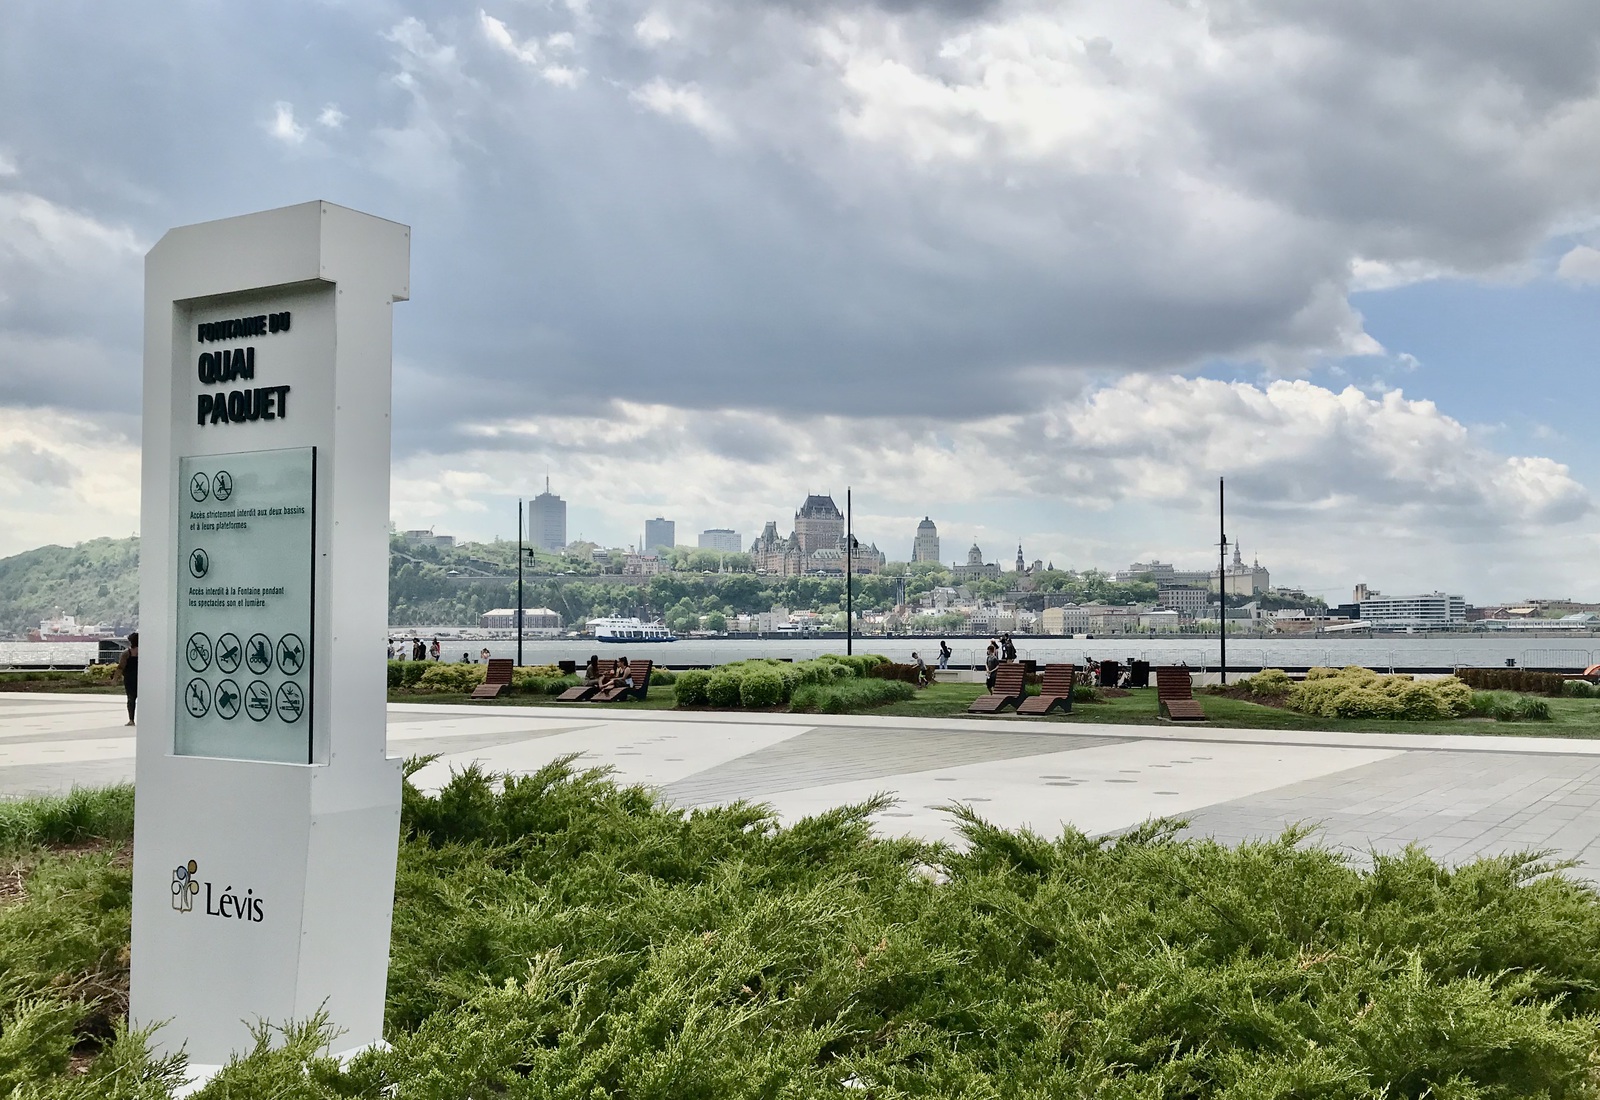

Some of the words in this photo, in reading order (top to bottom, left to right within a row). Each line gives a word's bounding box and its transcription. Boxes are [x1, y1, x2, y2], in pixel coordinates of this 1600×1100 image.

[198, 315, 267, 343] FONTAINE
[268, 311, 290, 333] DU
[198, 347, 255, 384] QUAI
[197, 385, 291, 425] PAQUET
[190, 511, 205, 519] Accès
[206, 510, 236, 519] strictement
[236, 509, 256, 518] interdit
[257, 509, 268, 517] aux
[269, 507, 282, 516] deux
[283, 506, 304, 514] bassins
[190, 522, 196, 531] et
[196, 522, 200, 531] à
[201, 521, 215, 531] leurs
[216, 520, 247, 531] plateformes
[189, 587, 204, 596] Accès
[205, 587, 224, 596] interdit
[225, 586, 229, 596] à
[230, 586, 236, 596] la
[238, 586, 261, 596] Fontaine
[262, 586, 284, 596] pendant
[188, 598, 197, 607] les
[198, 598, 226, 608] spectacles
[226, 599, 237, 607] son
[238, 599, 244, 607] et
[244, 598, 265, 606] lumière
[204, 881, 265, 923] Lévis
